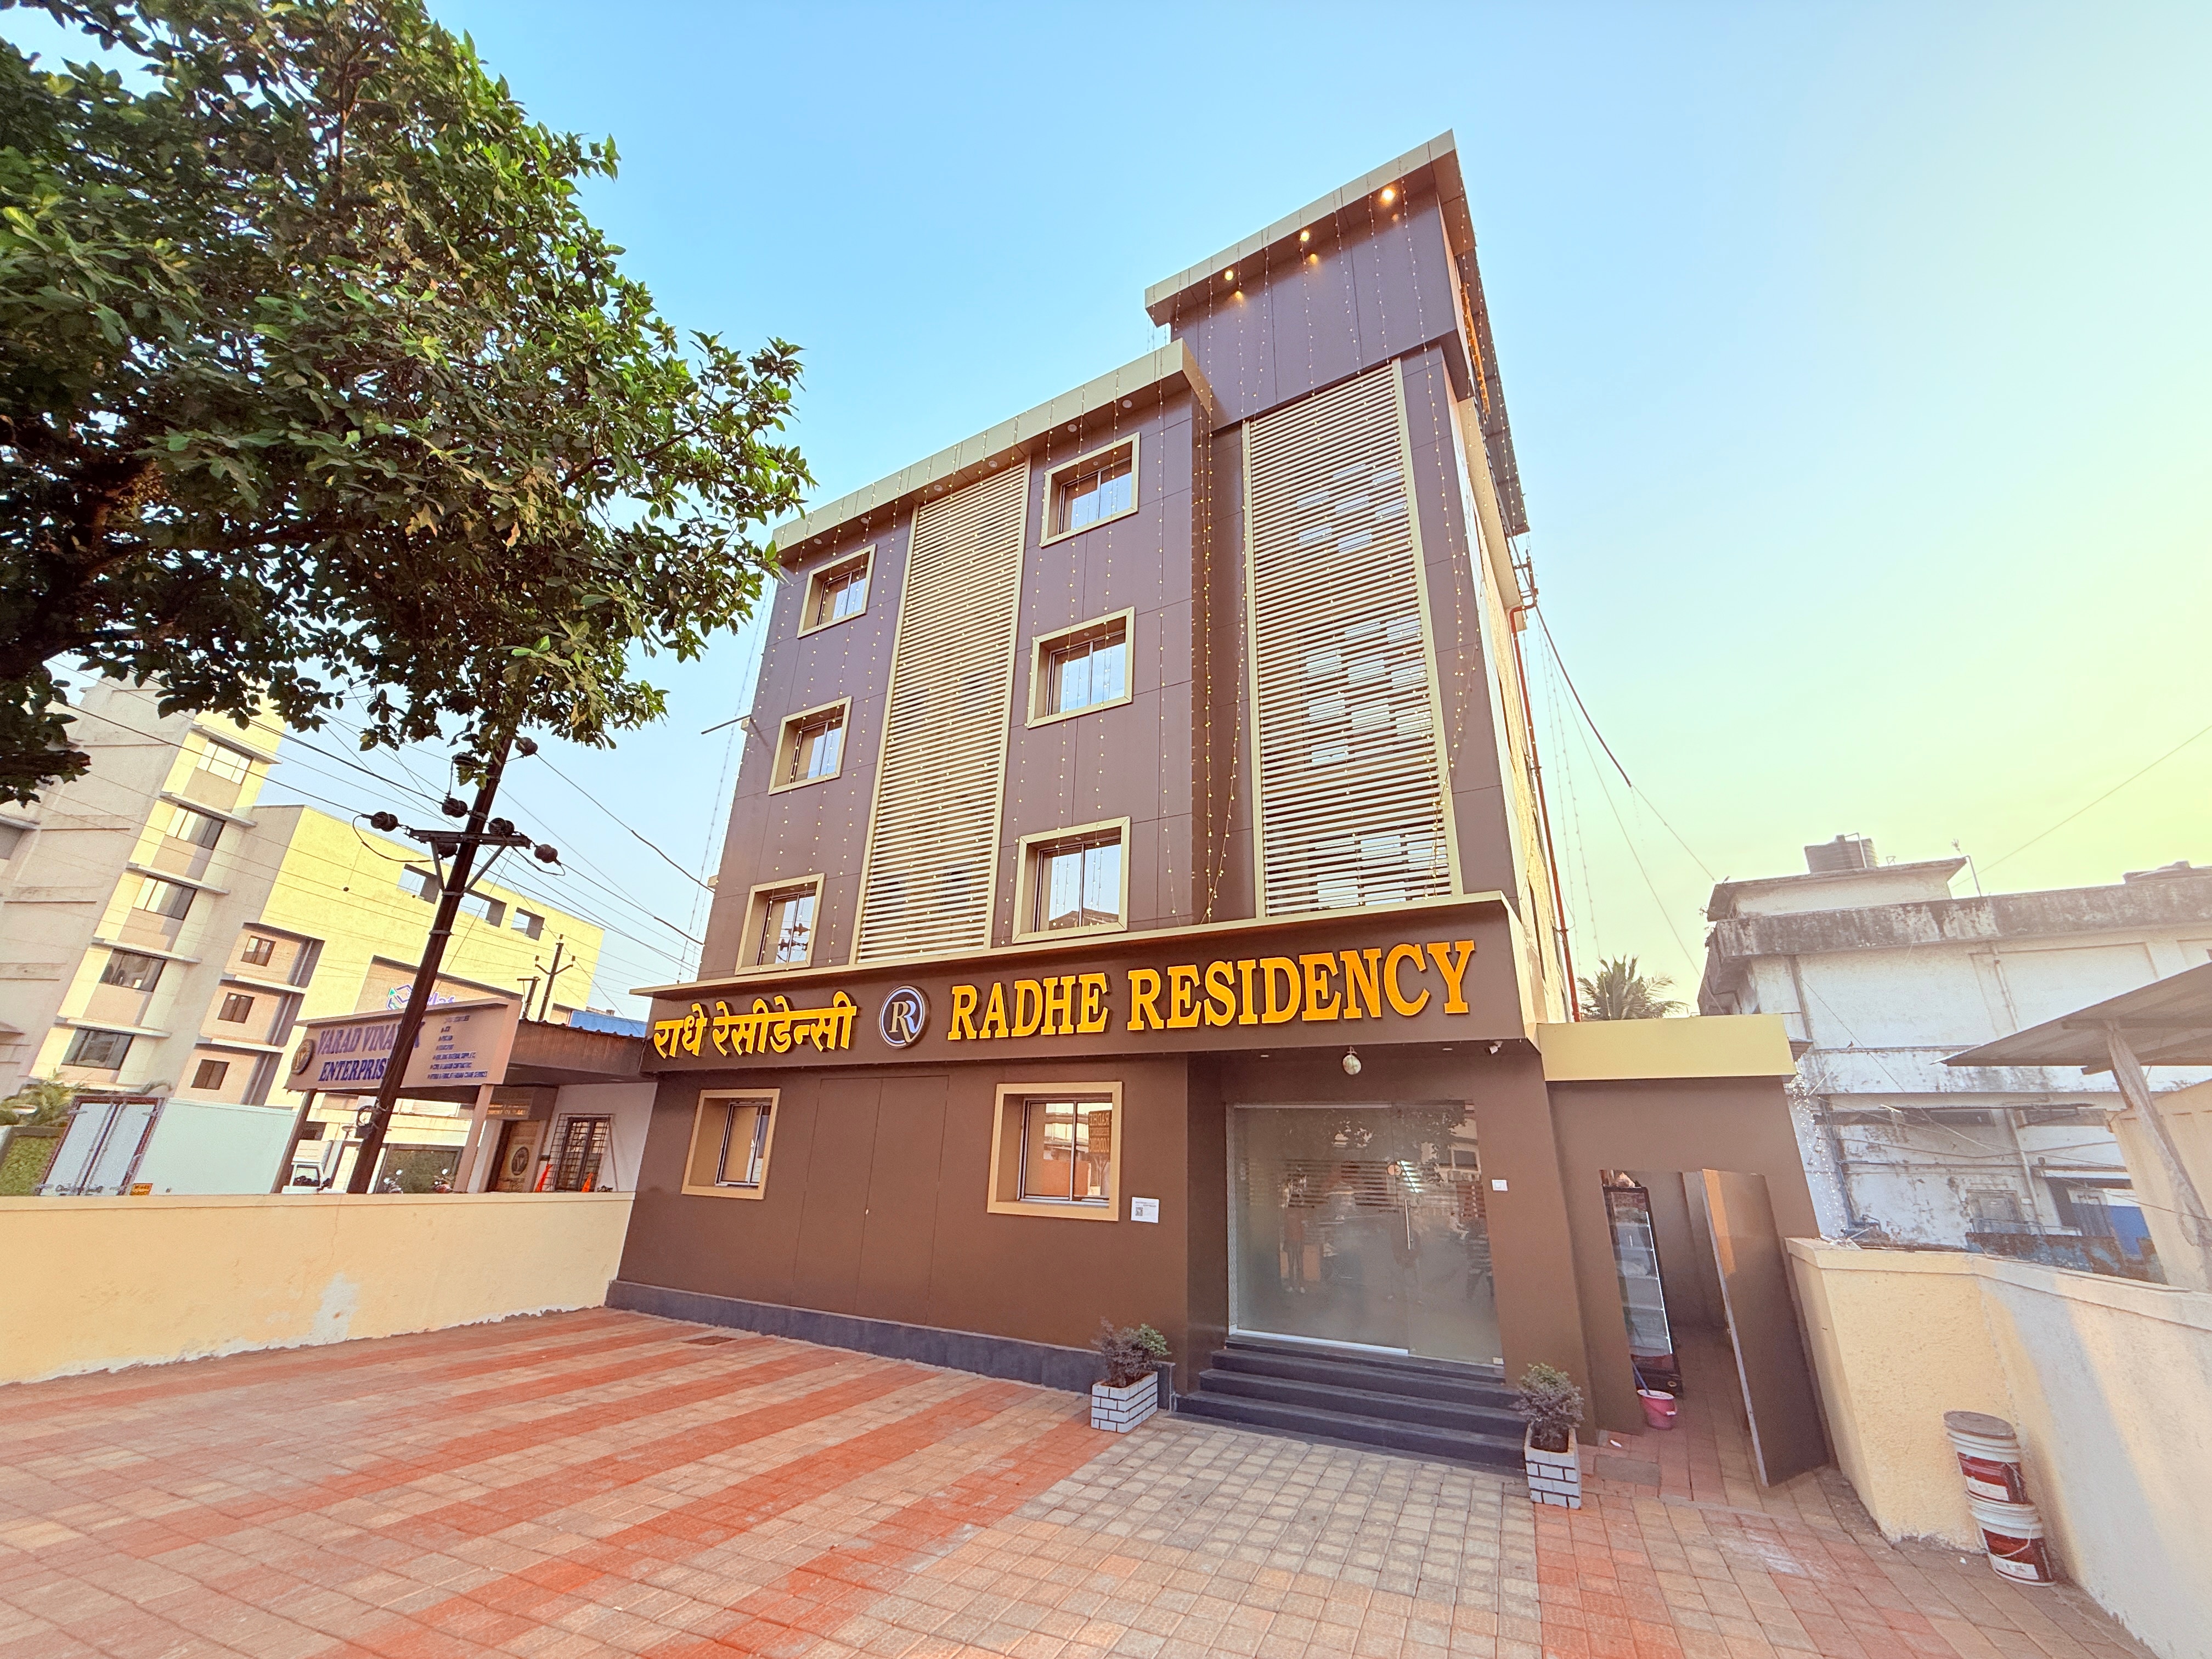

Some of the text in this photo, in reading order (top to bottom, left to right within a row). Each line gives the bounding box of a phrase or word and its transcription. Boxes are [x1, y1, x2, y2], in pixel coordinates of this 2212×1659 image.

[948, 940, 1476, 1040] RADHE RESIDENCY
[318, 1021, 425, 1054] VARAD VINA
[653, 991, 857, 1059] राधे रेसीडेन्सी
[318, 1058, 390, 1081] ENTERPRIS
